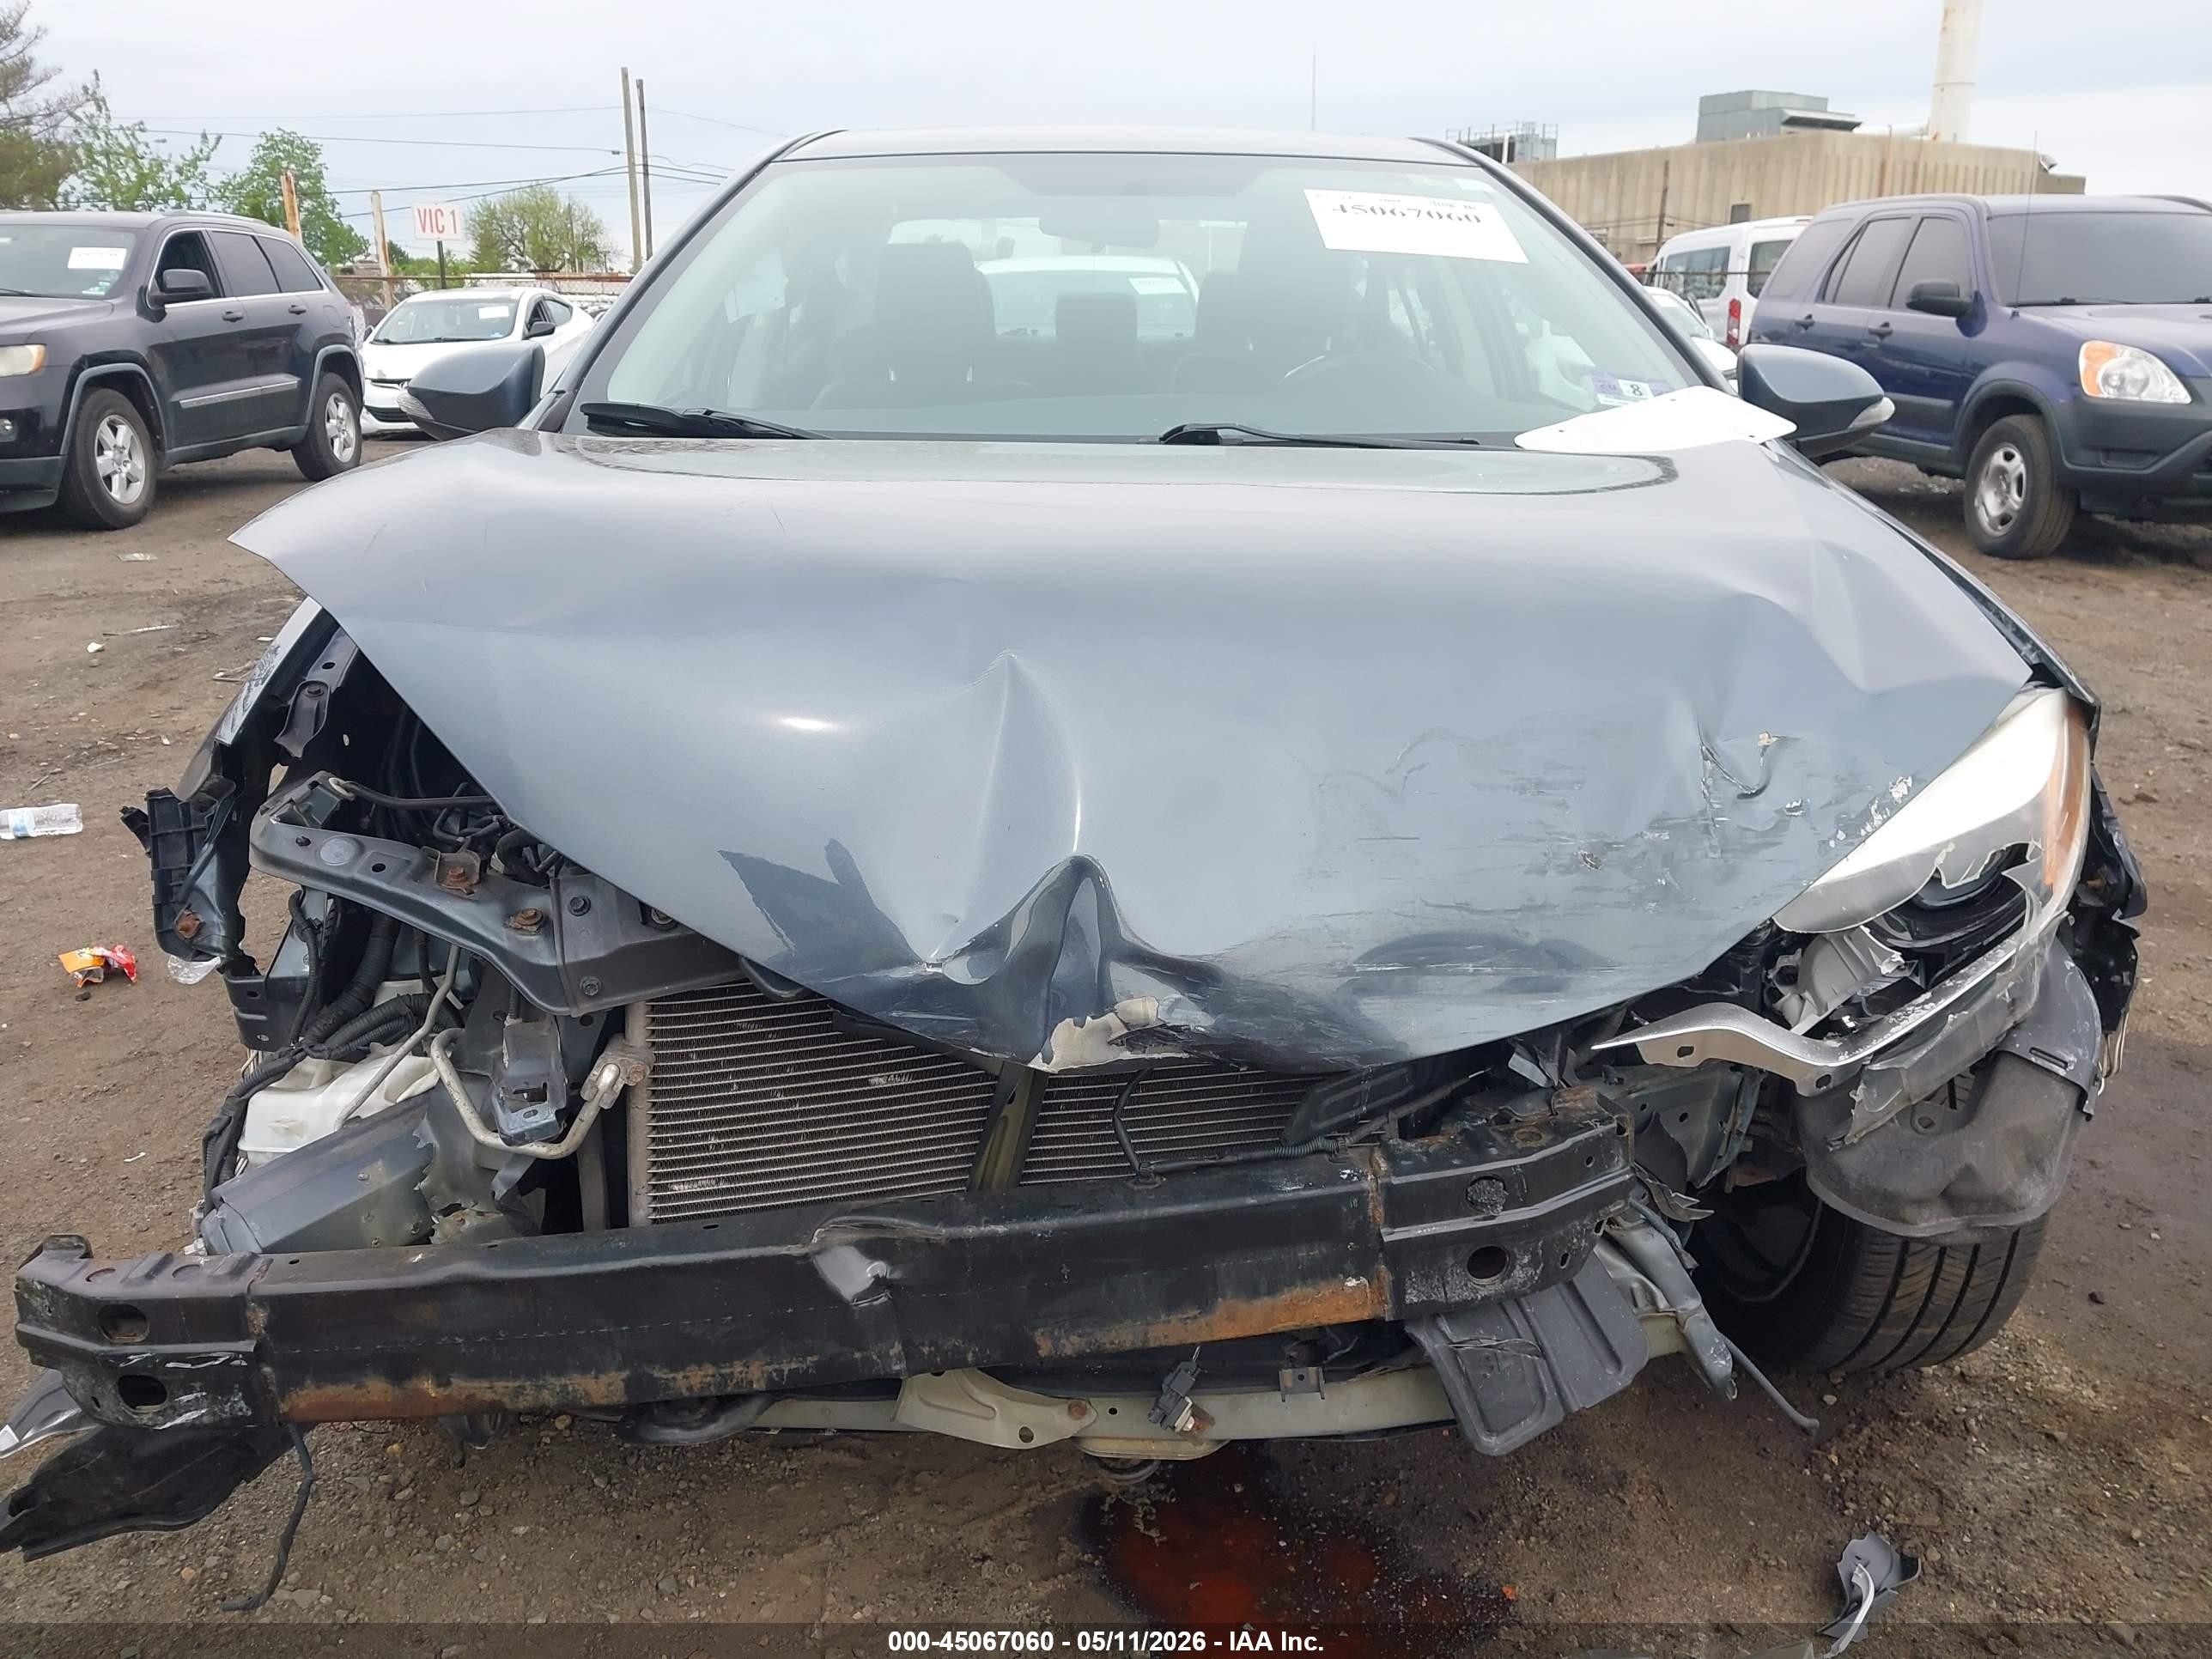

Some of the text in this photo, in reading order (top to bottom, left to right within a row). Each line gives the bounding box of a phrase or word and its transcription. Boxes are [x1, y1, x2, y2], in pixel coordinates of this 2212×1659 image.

[417, 208, 457, 234] VIC 1
[1631, 384, 1643, 396] 8
